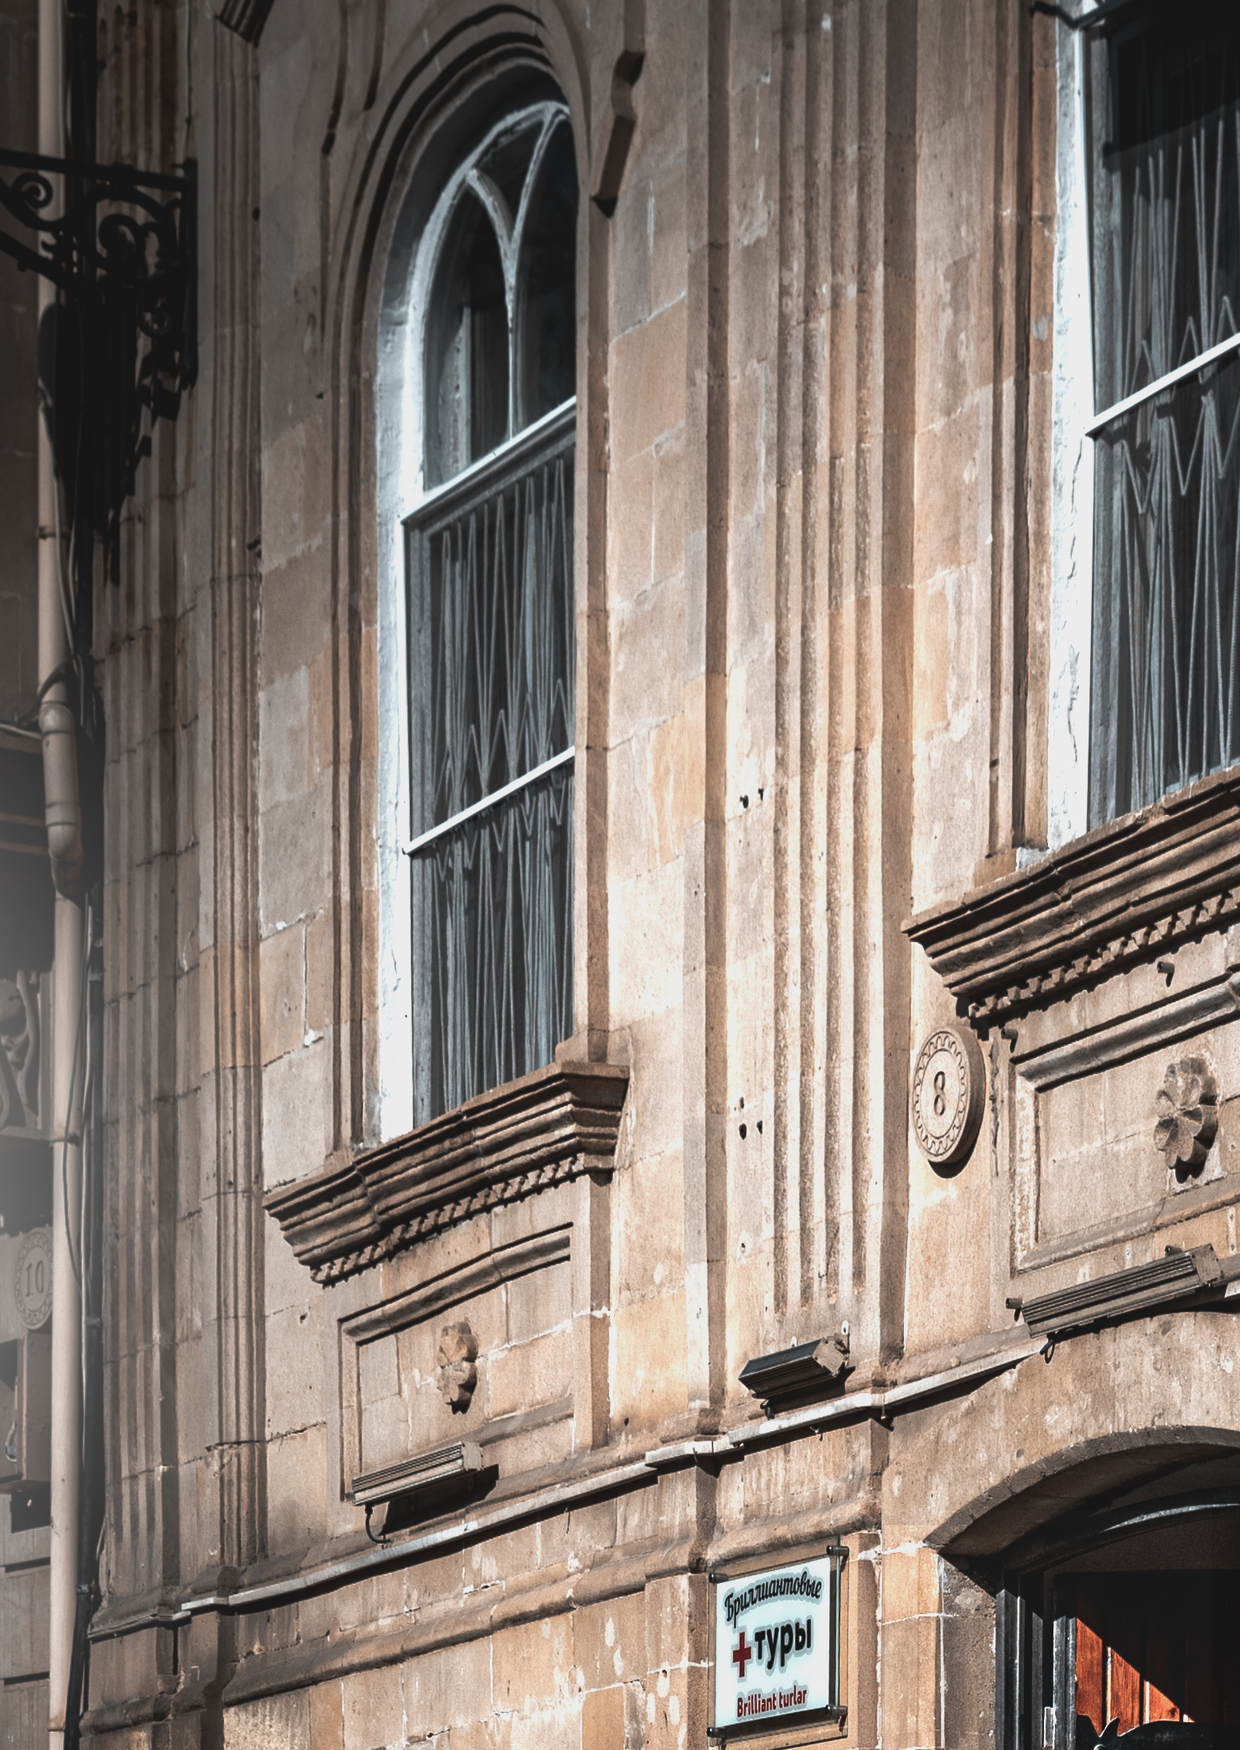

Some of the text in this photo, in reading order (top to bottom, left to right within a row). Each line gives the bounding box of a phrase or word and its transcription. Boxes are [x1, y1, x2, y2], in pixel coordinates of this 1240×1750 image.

[934, 1071, 945, 1116] 8
[25, 1260, 44, 1297] 10
[724, 1570, 823, 1629] Бриллиантовые
[754, 1618, 812, 1670] туры
[736, 1685, 808, 1717] Brilliant turlar
